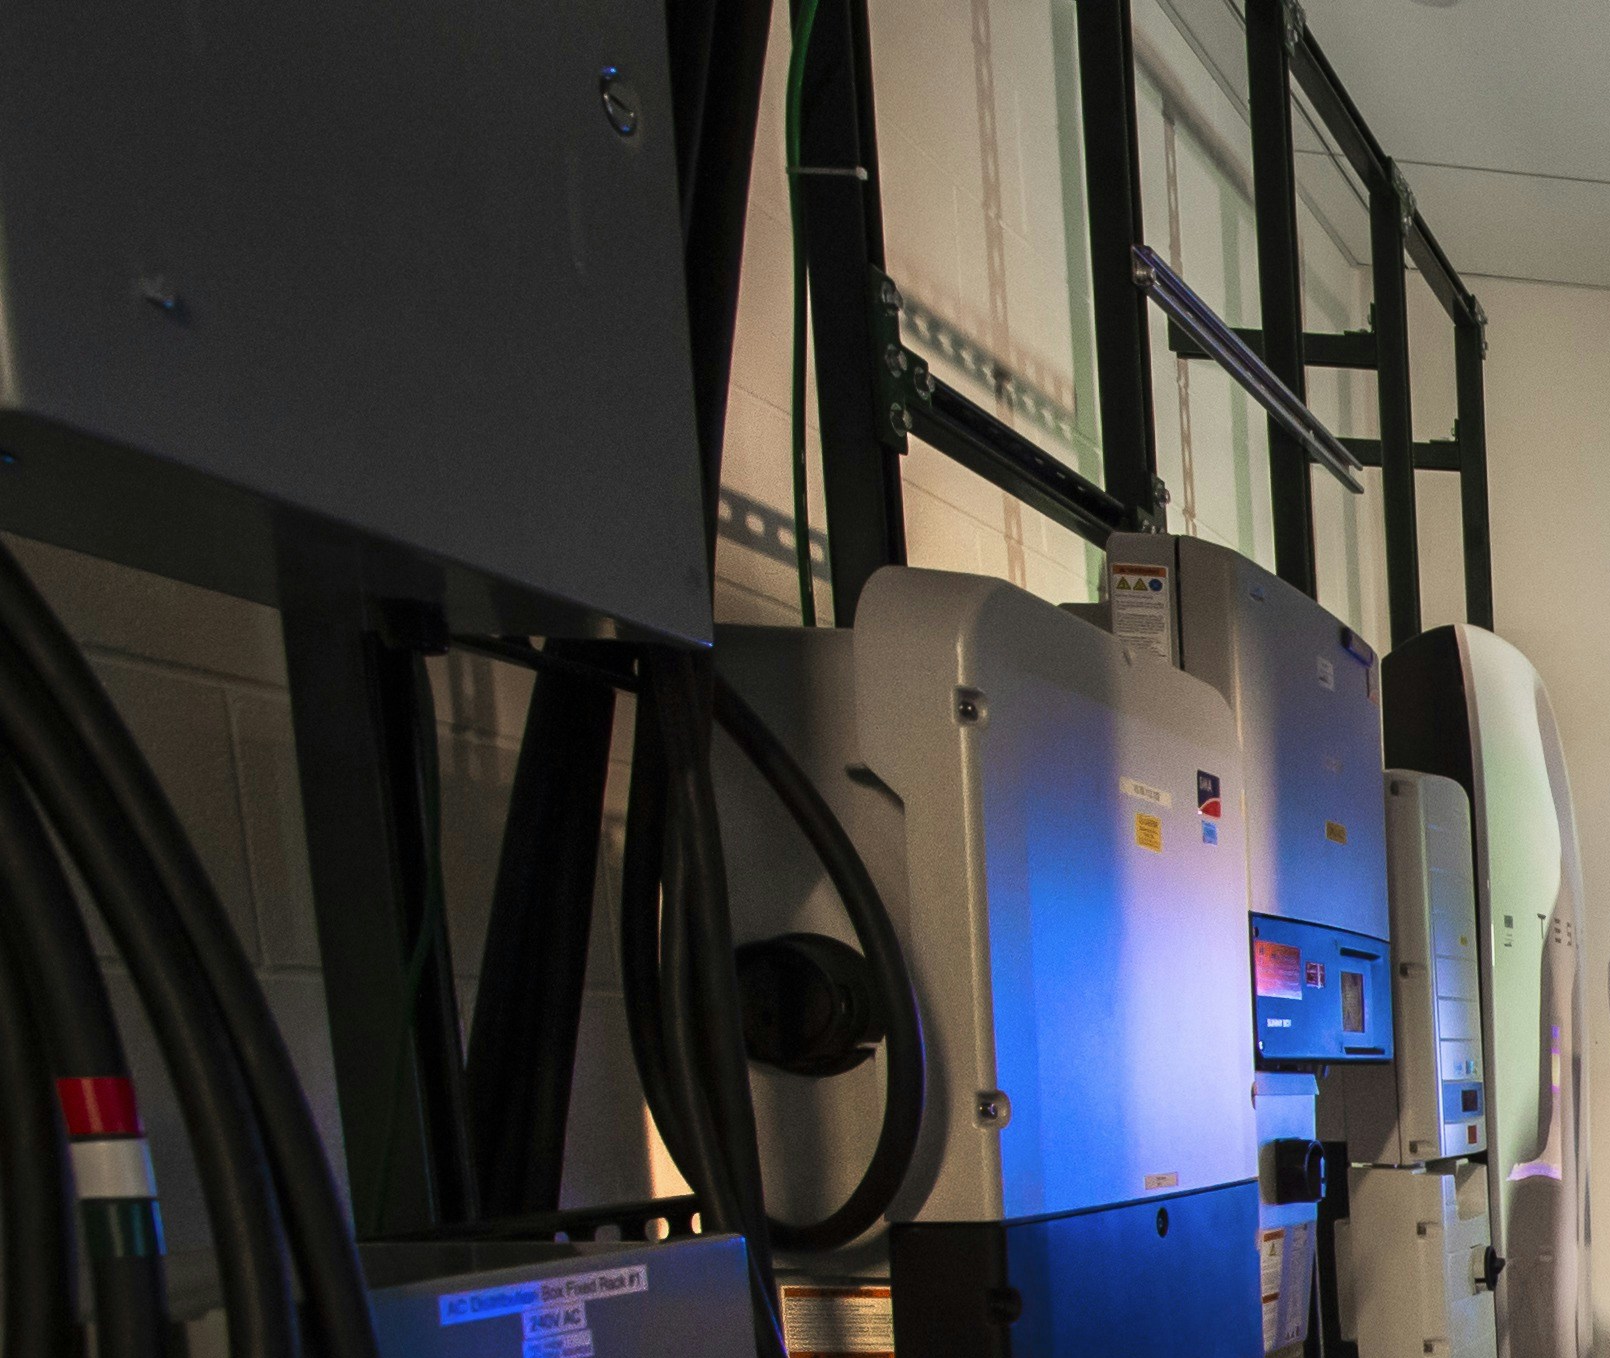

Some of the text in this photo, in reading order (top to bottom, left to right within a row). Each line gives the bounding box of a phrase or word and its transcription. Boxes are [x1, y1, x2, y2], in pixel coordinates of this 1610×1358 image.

[447, 1297, 468, 1315] AC
[541, 1283, 564, 1302] Box
[565, 1279, 598, 1297] Fixed
[598, 1275, 627, 1292] Rack
[562, 1307, 582, 1326] AC
